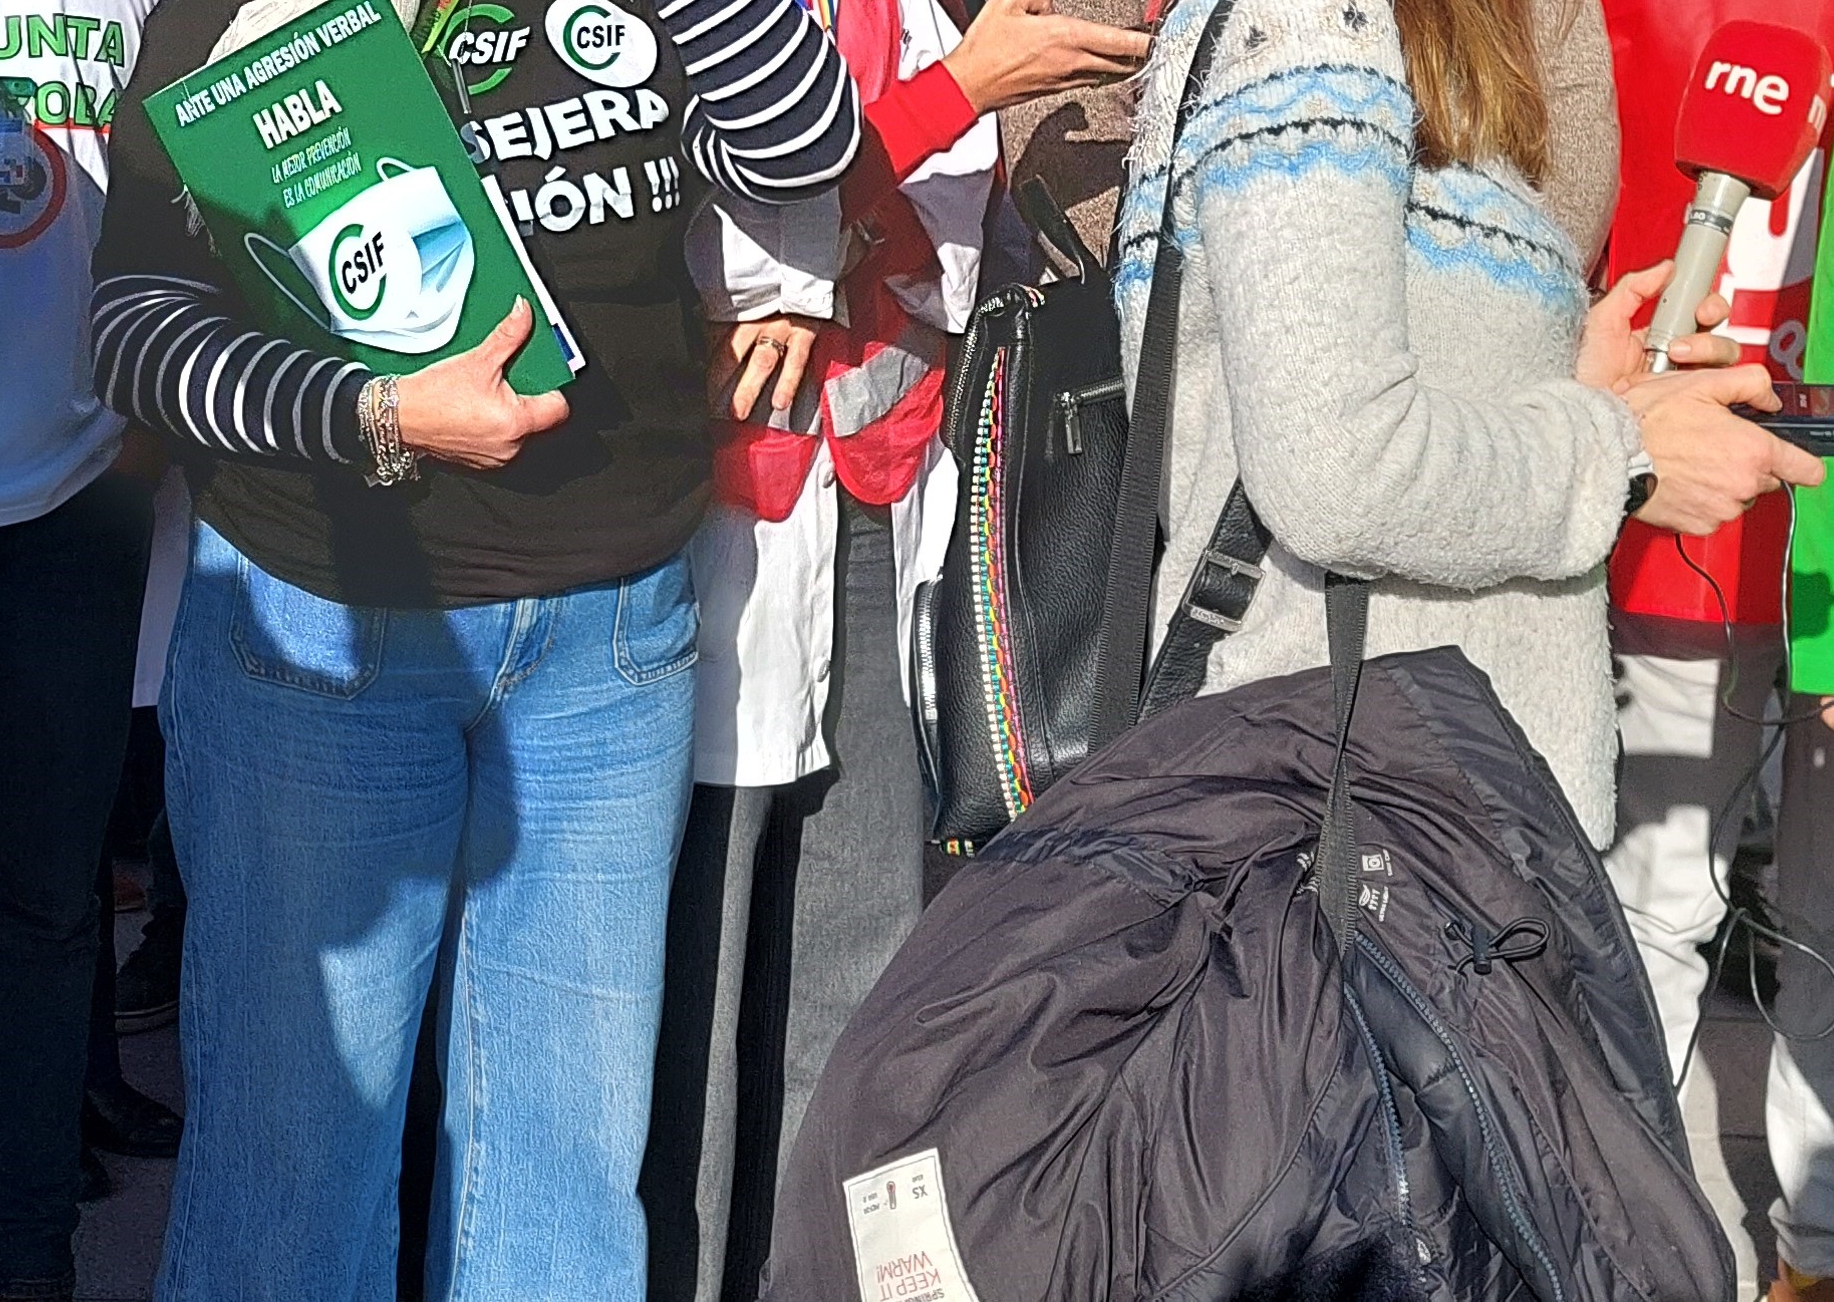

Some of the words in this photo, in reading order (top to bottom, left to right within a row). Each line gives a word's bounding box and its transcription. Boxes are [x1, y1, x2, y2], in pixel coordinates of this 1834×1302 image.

[175, 89, 215, 127] ANTE
[210, 73, 247, 105] UNA
[243, 31, 321, 89] AGRESIÓN
[316, 0, 382, 47] VERBAL
[449, 26, 530, 65] CSIF
[252, 79, 343, 149] HABLA
[1704, 59, 1790, 115] rne
[460, 88, 669, 164] SEJERA
[271, 164, 283, 183] LA
[281, 151, 308, 179] MEJOR
[306, 126, 352, 166] PREVENCIÓN
[282, 187, 295, 208] ES
[294, 182, 305, 202] LA
[304, 150, 362, 198] COMUNICACIÓN
[644, 156, 680, 212] !!!
[342, 231, 384, 294] CSIF
[912, 1185, 928, 1199] XS
[876, 1251, 933, 1283] WARM!
[880, 1283, 893, 1301] IT
[897, 1268, 941, 1296] KEEP
